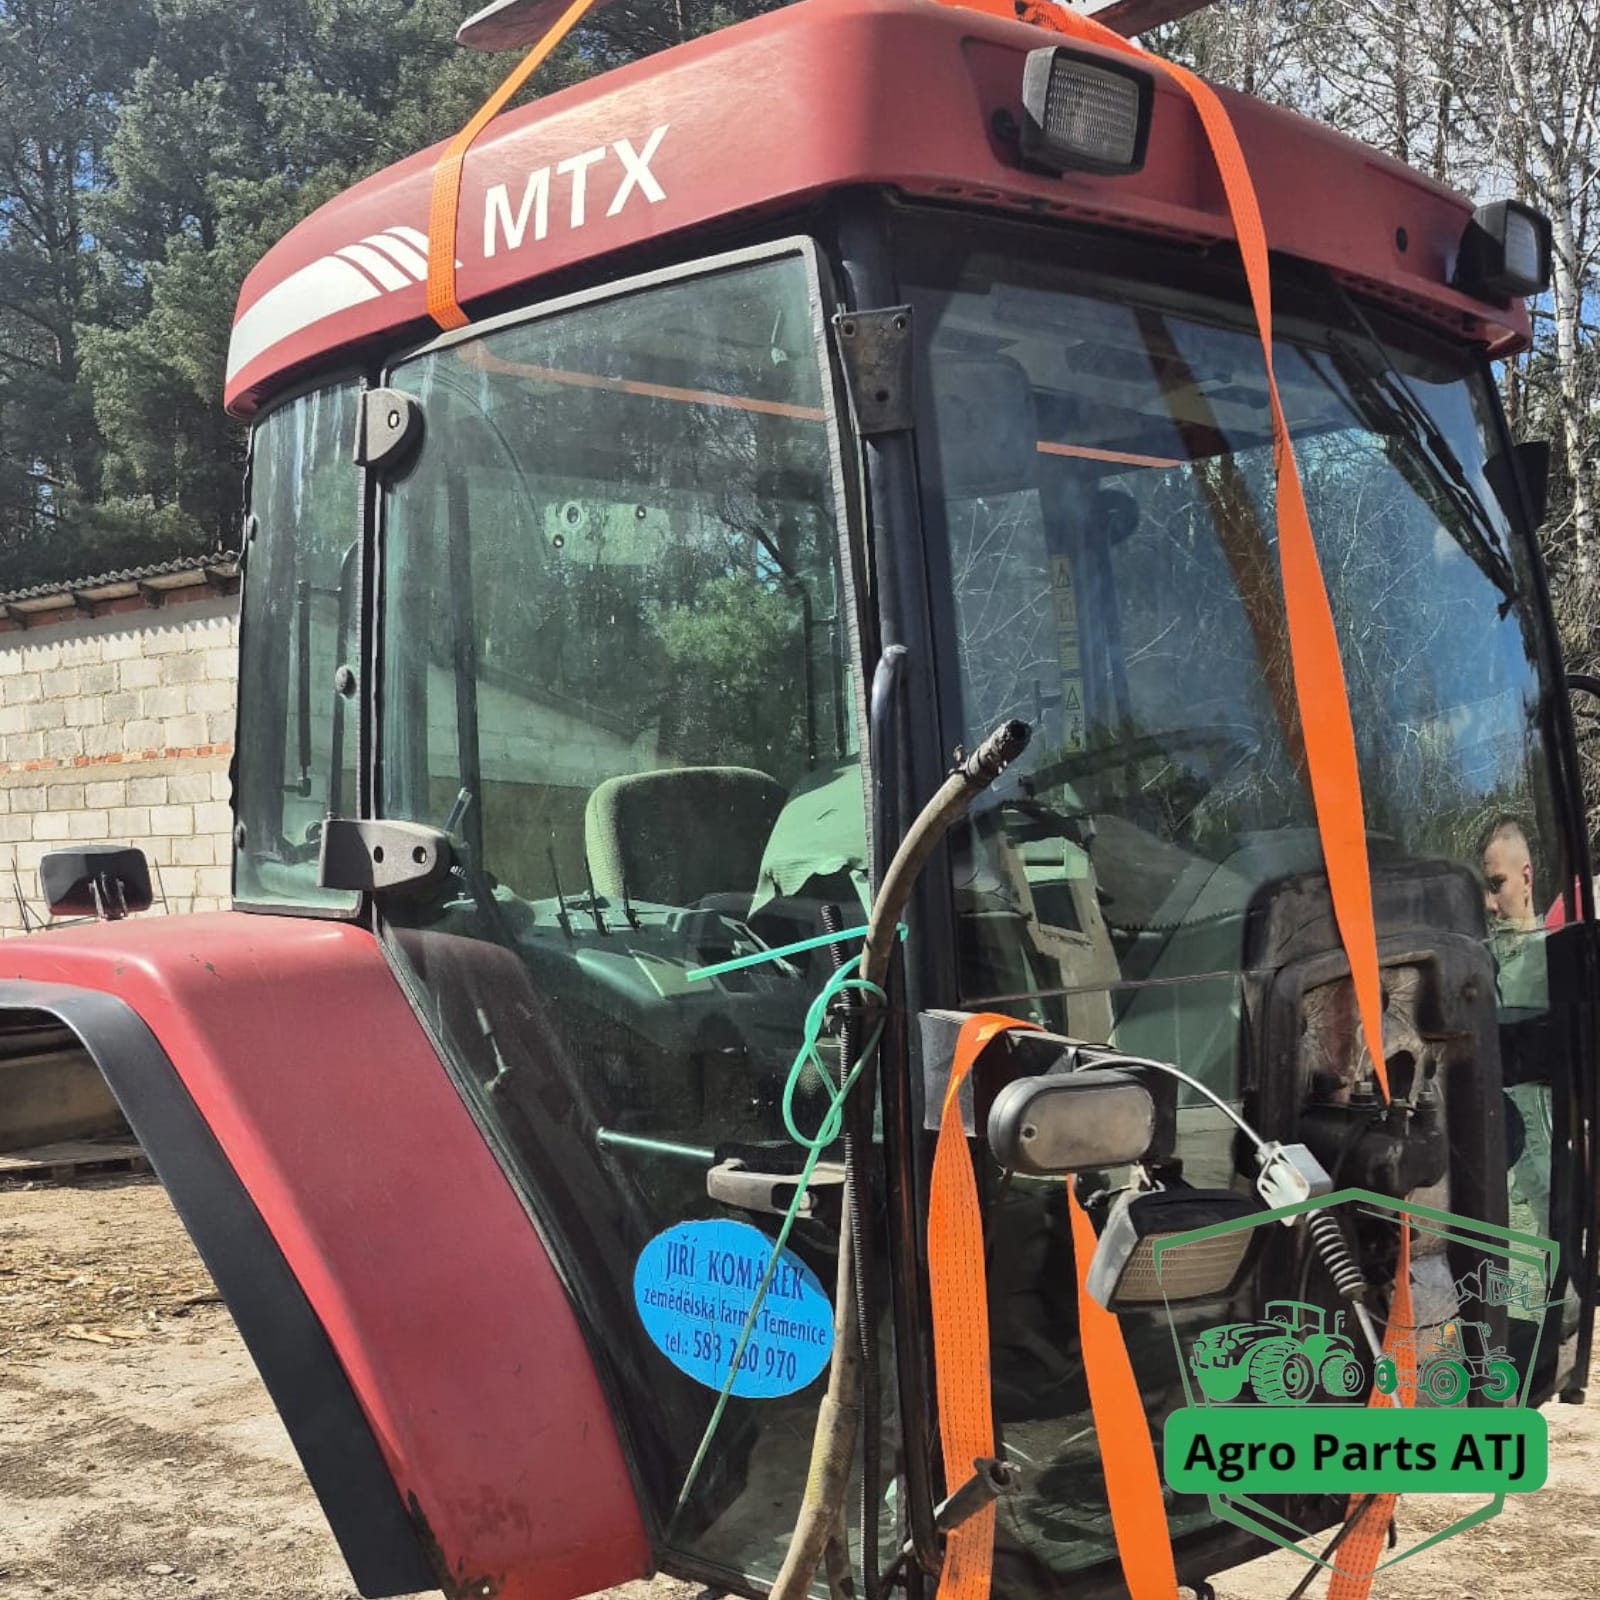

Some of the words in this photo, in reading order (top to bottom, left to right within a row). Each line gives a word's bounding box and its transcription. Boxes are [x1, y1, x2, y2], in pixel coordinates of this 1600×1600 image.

[484, 124, 670, 258] MTX
[666, 1234, 698, 1280] JIŘÍ
[707, 1249, 805, 1301] KOMÁREK
[644, 1287, 716, 1320] zemědělská
[761, 1308, 826, 1346] Temenice
[664, 1332, 689, 1355] tel.:
[692, 1329, 722, 1364] 583
[765, 1346, 797, 1382] 970
